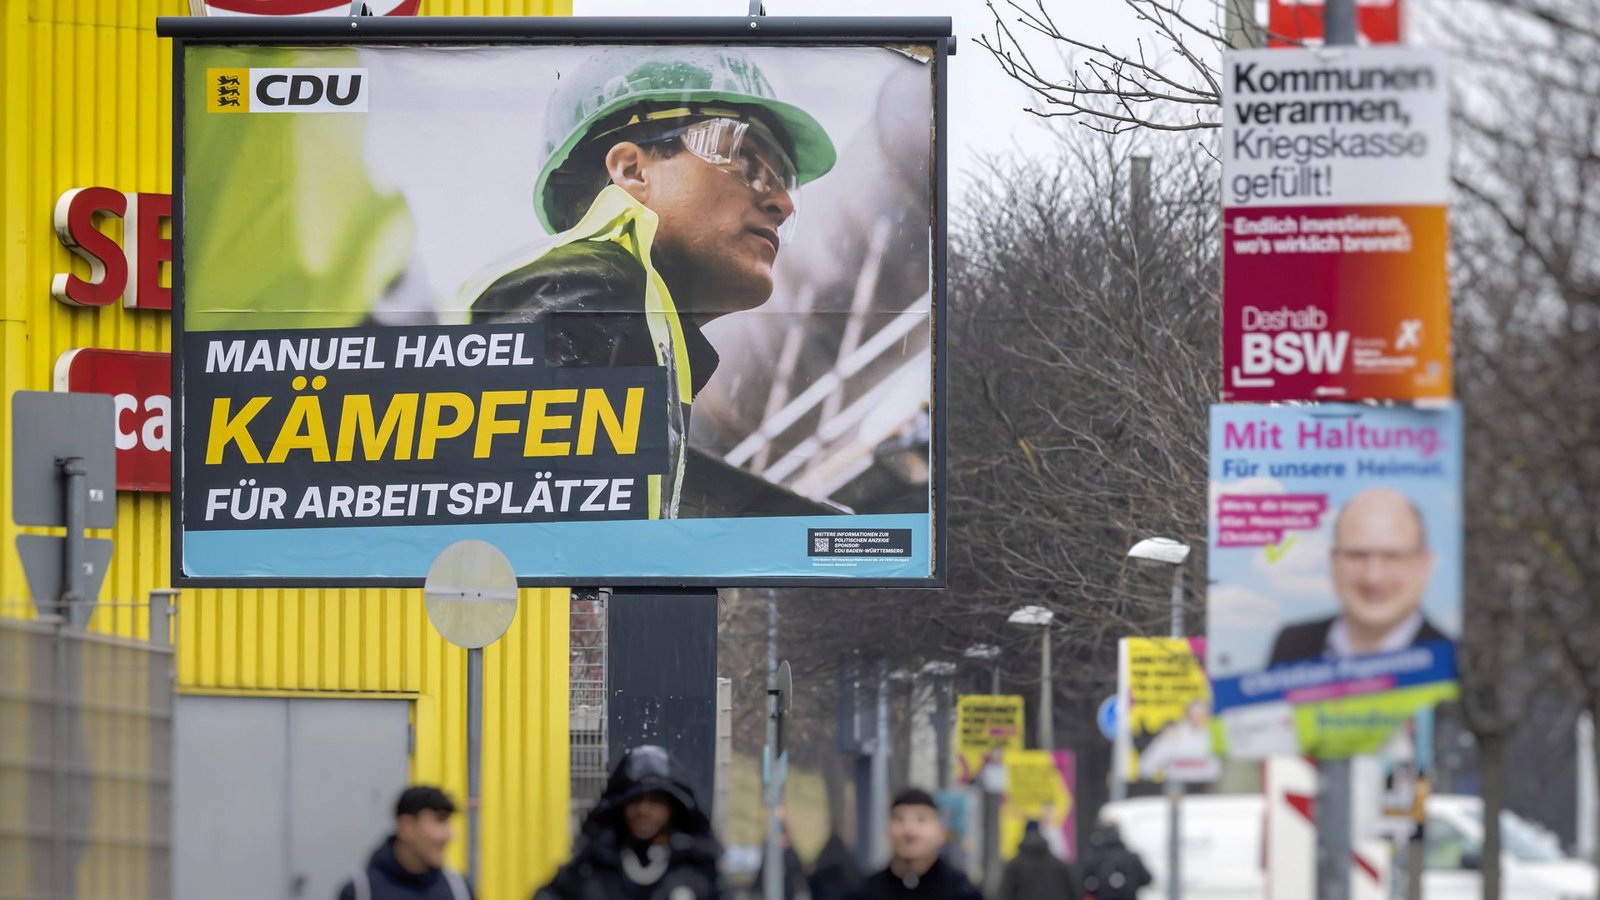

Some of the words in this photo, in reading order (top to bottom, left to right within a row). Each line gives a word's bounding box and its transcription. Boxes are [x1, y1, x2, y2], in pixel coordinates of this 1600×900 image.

[255, 75, 362, 106] CDU
[1234, 63, 1435, 93] Kommunen
[1235, 99, 1411, 127] verarmen,
[1233, 127, 1427, 164] Kriegskasse
[1232, 165, 1332, 204] gefüllt!
[1234, 216, 1298, 235] Endlich
[1300, 215, 1409, 234] investieren,
[1233, 236, 1271, 254] wo's
[1274, 235, 1340, 253] wirklich
[1343, 234, 1412, 252] brennt!
[1242, 305, 1328, 331] Deshalb
[205, 337, 385, 373] MANUEL
[395, 333, 535, 369] HAGEL
[1242, 331, 1350, 374] BSW
[205, 375, 645, 465] KÄMPFEN
[1224, 421, 1282, 450] Mit
[1298, 420, 1446, 459] Haltung.
[1222, 459, 1259, 478] Für
[1269, 460, 1346, 477] unsere
[205, 478, 287, 521] FÜR
[295, 471, 635, 519] ARBEITSPLÄTZE
